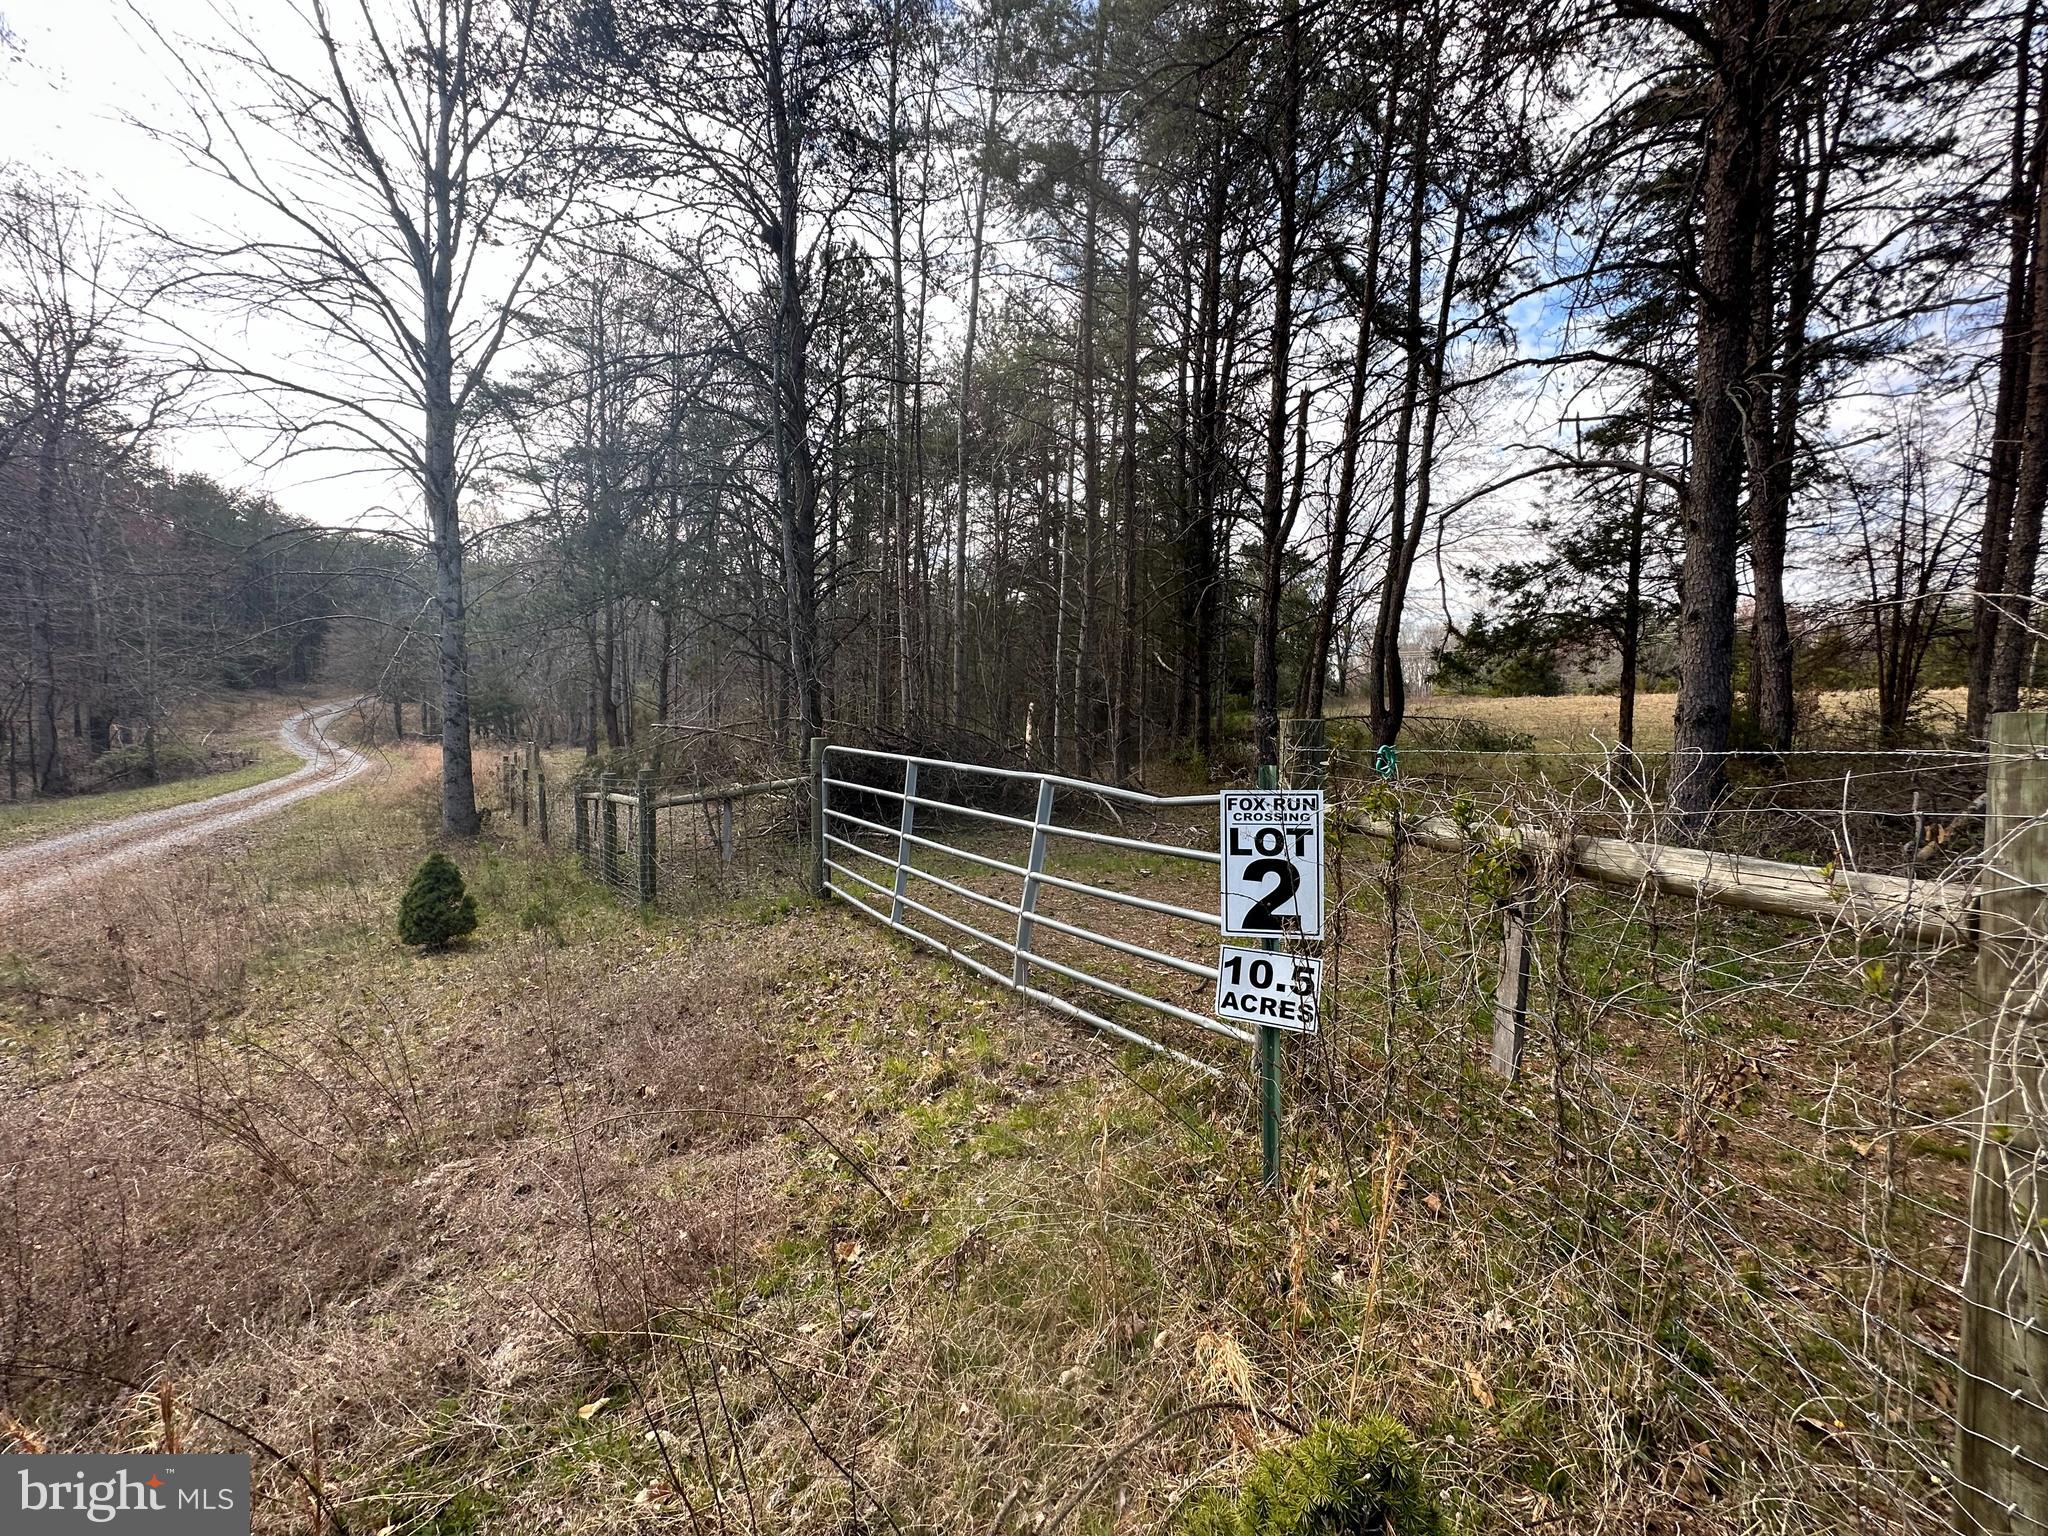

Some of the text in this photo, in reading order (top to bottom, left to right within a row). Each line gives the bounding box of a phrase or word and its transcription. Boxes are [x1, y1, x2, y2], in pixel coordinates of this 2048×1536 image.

[1227, 797, 1316, 811] FOX RUN
[1233, 812, 1311, 822] CROSSING
[1229, 827, 1314, 857] LOT
[1241, 858, 1302, 930] 2
[1224, 955, 1315, 997] 10.5
[1220, 991, 1315, 1025] ACRES
